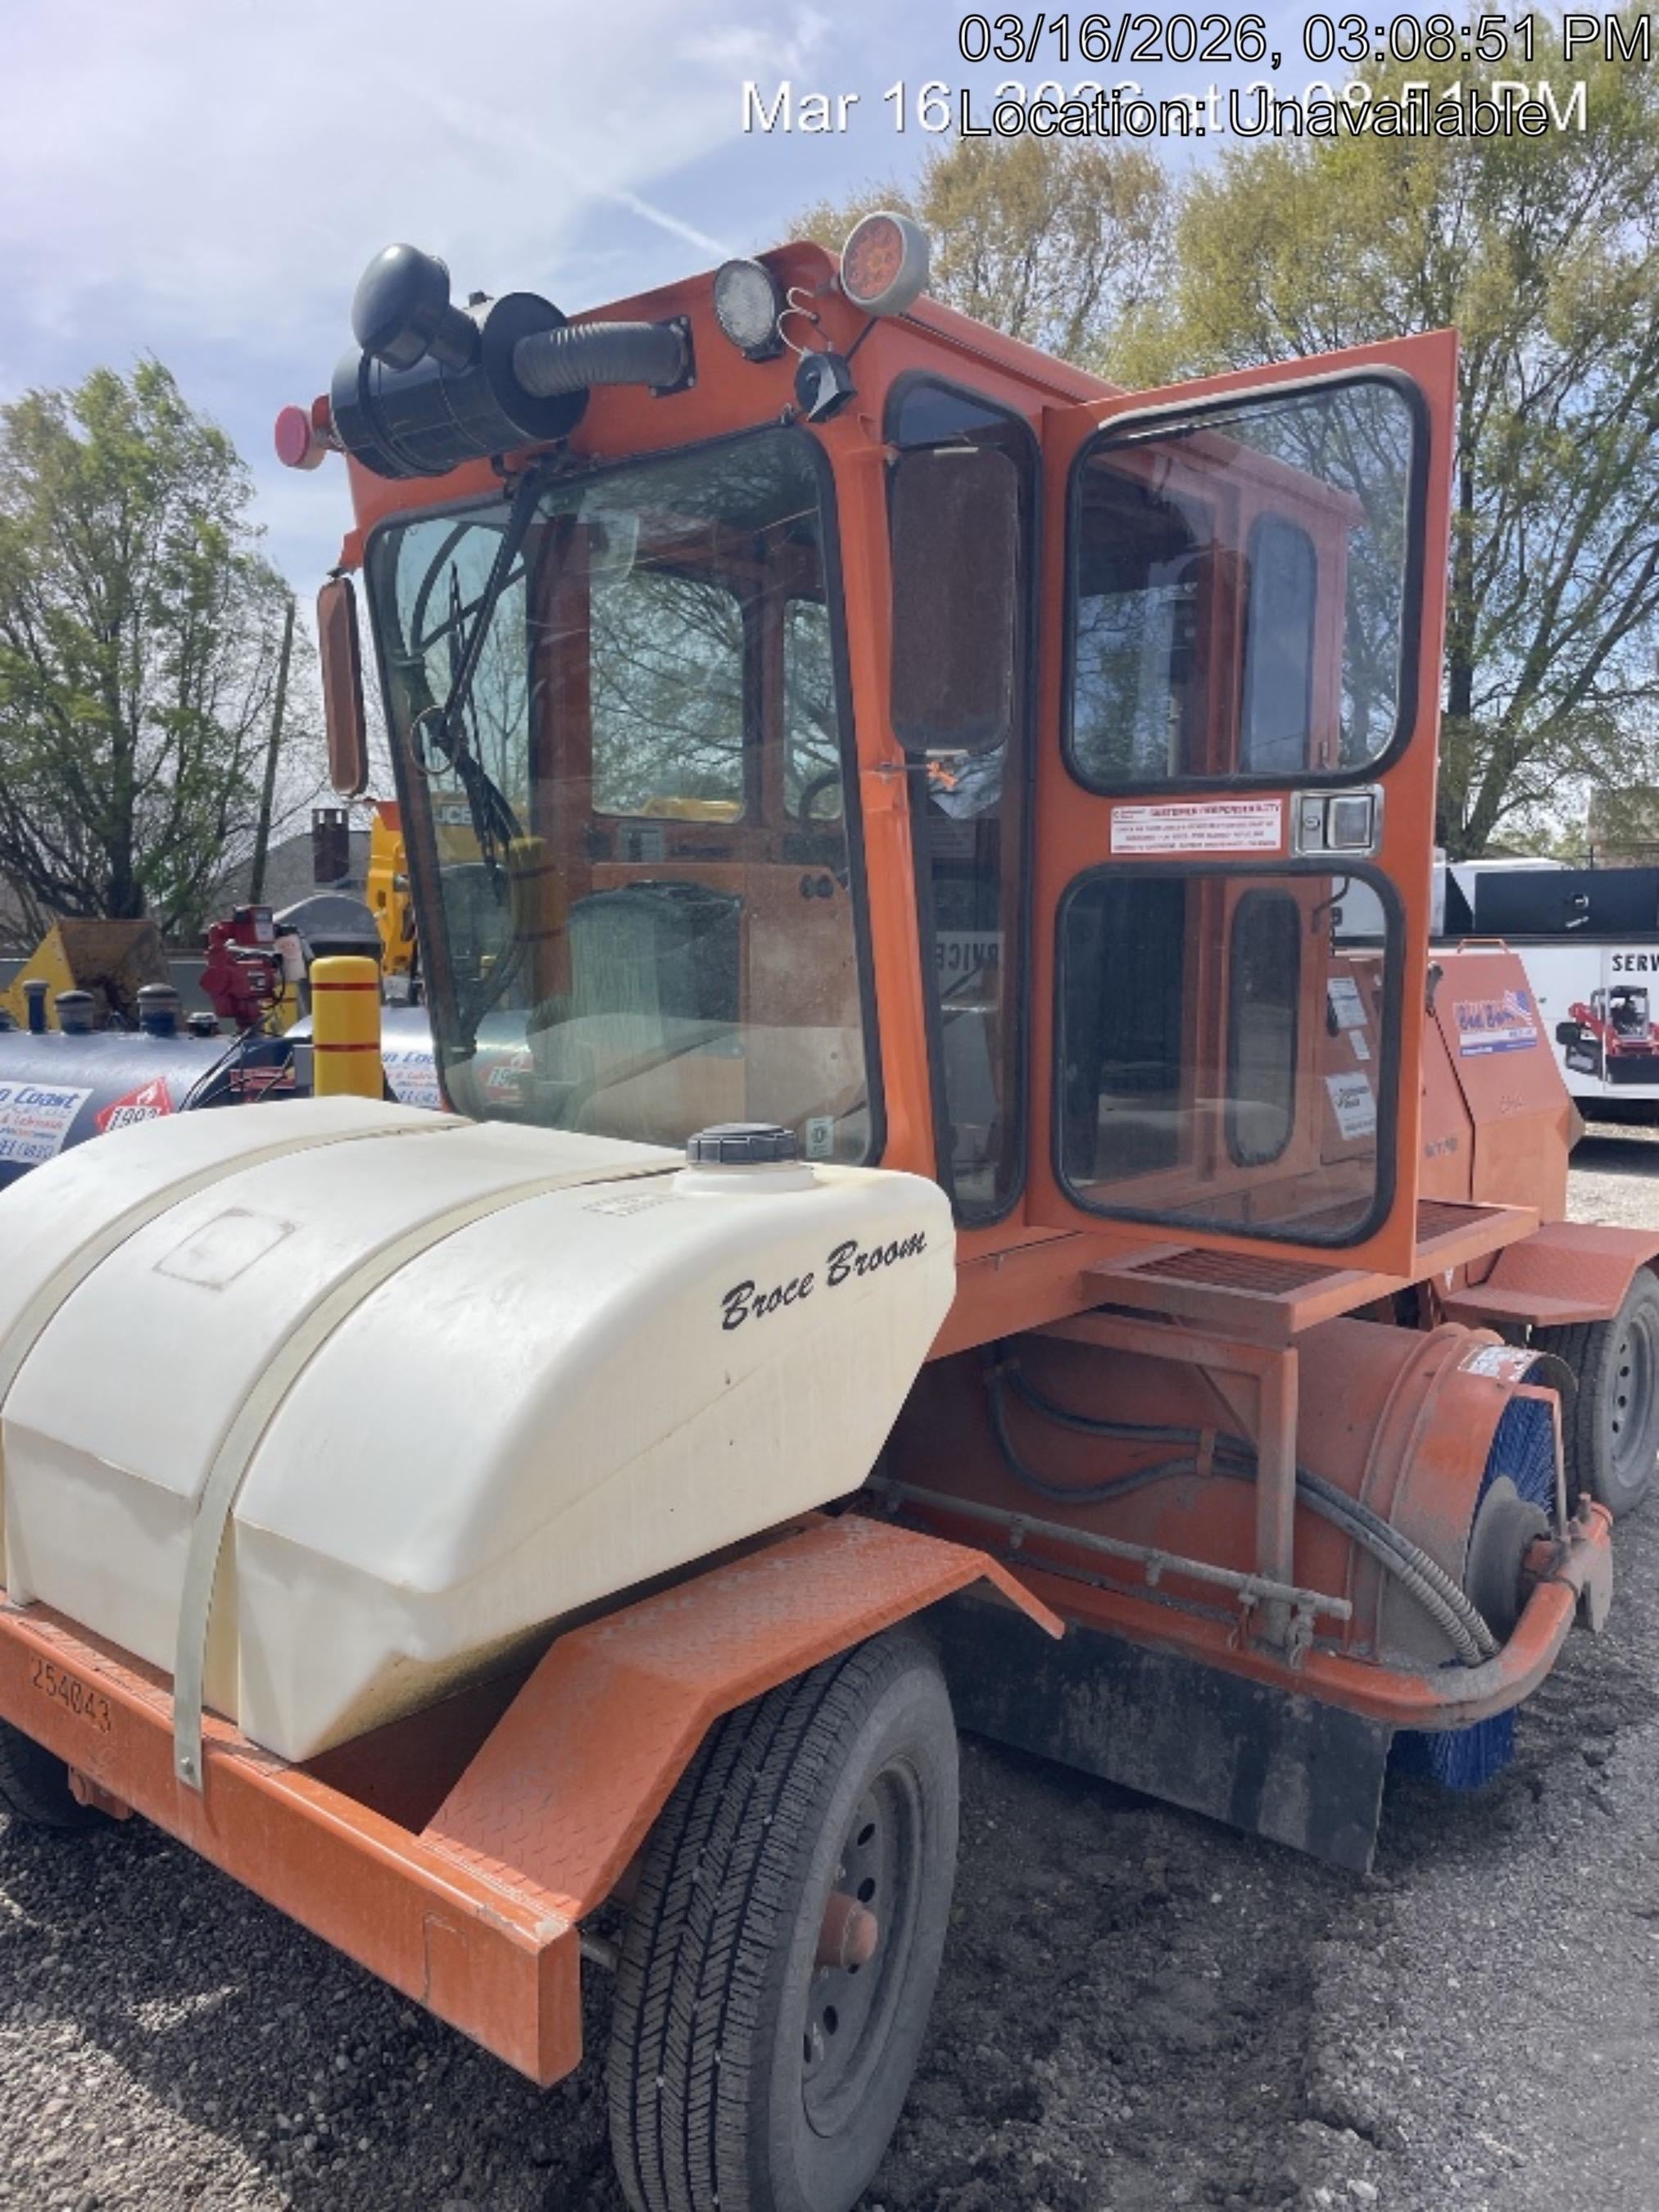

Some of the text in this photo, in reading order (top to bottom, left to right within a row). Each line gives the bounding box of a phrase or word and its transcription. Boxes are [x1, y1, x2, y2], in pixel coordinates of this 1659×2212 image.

[720, 1231, 927, 1330] Broce Broom
[31, 1657, 111, 1734] 254043
